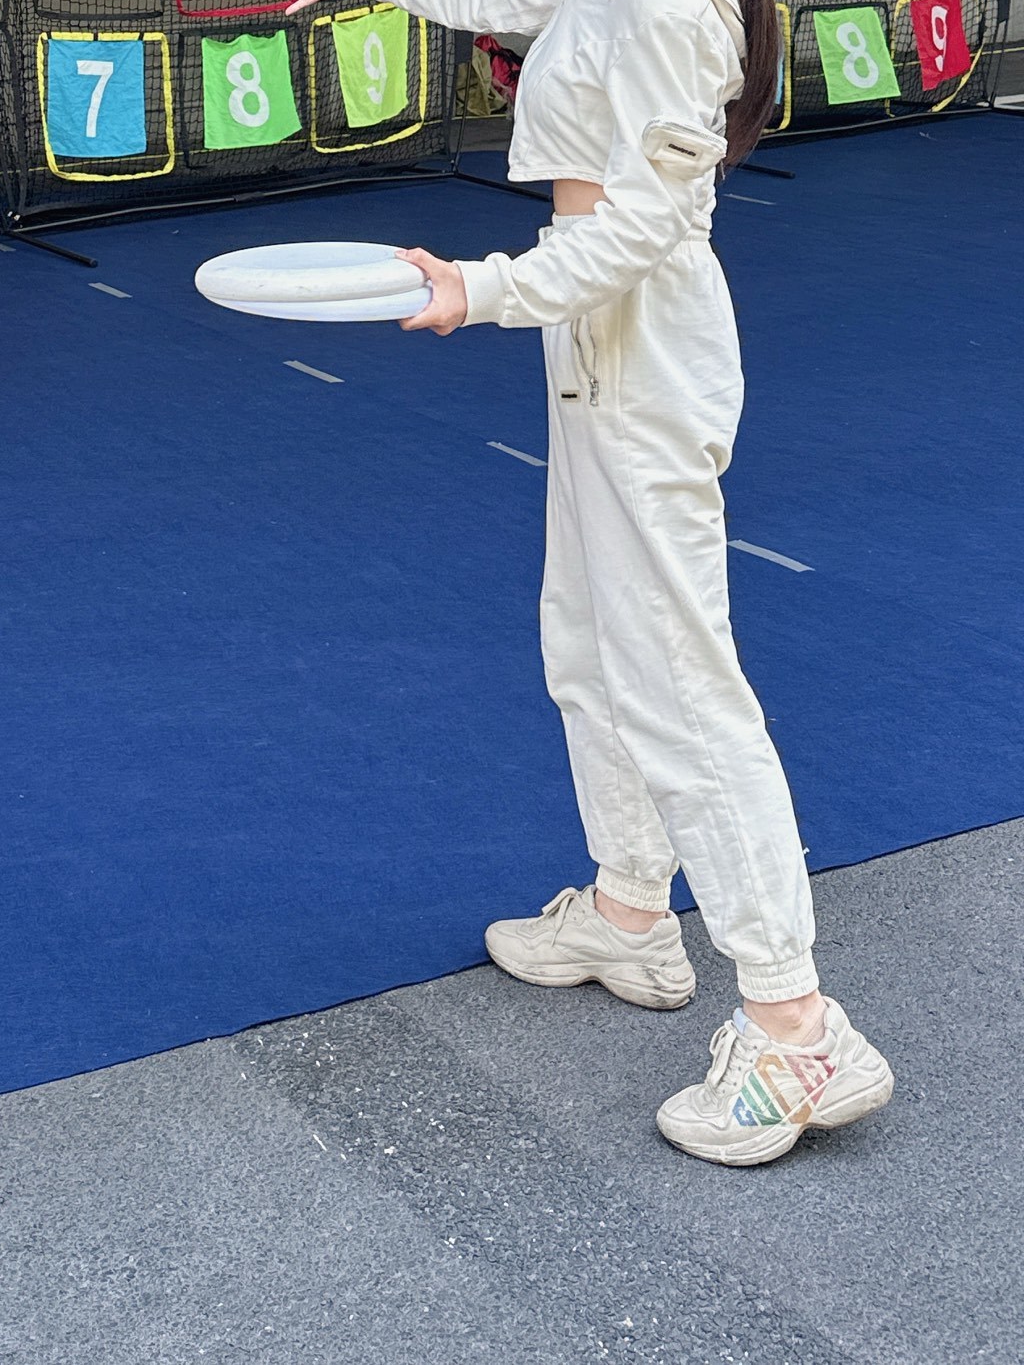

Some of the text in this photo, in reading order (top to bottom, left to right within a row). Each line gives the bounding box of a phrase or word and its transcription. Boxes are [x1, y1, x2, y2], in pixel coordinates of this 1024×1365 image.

[363, 31, 387, 105] 9
[835, 21, 879, 89] 8
[931, 5, 949, 72] 9
[77, 61, 115, 138] 7
[225, 52, 271, 128] 8
